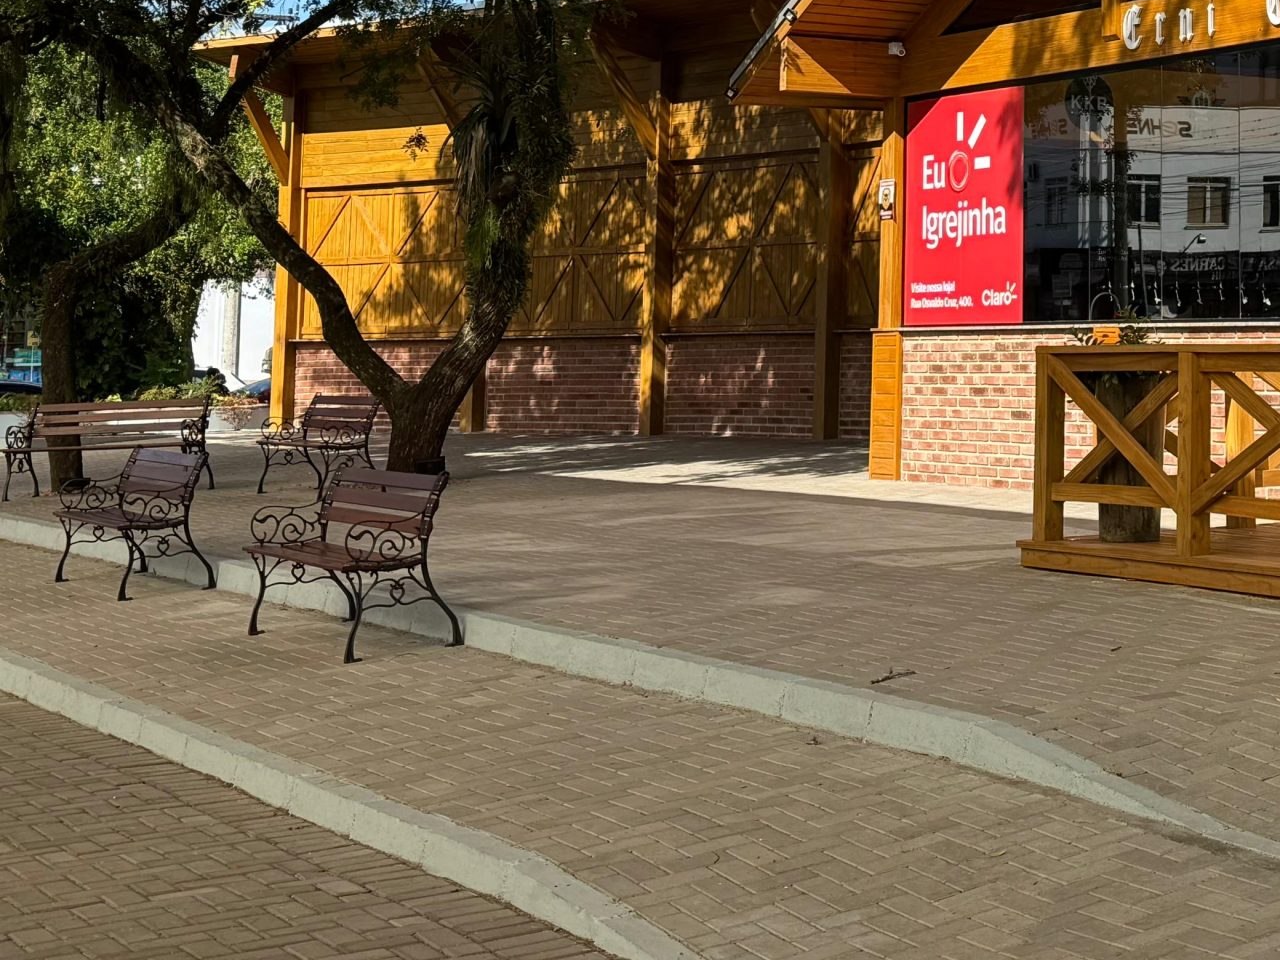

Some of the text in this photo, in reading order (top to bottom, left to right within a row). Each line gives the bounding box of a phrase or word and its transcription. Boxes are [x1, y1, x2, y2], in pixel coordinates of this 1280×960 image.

[922, 154, 946, 190] Eu
[922, 197, 1007, 249] Igrejinha
[981, 286, 1013, 306] Claro
